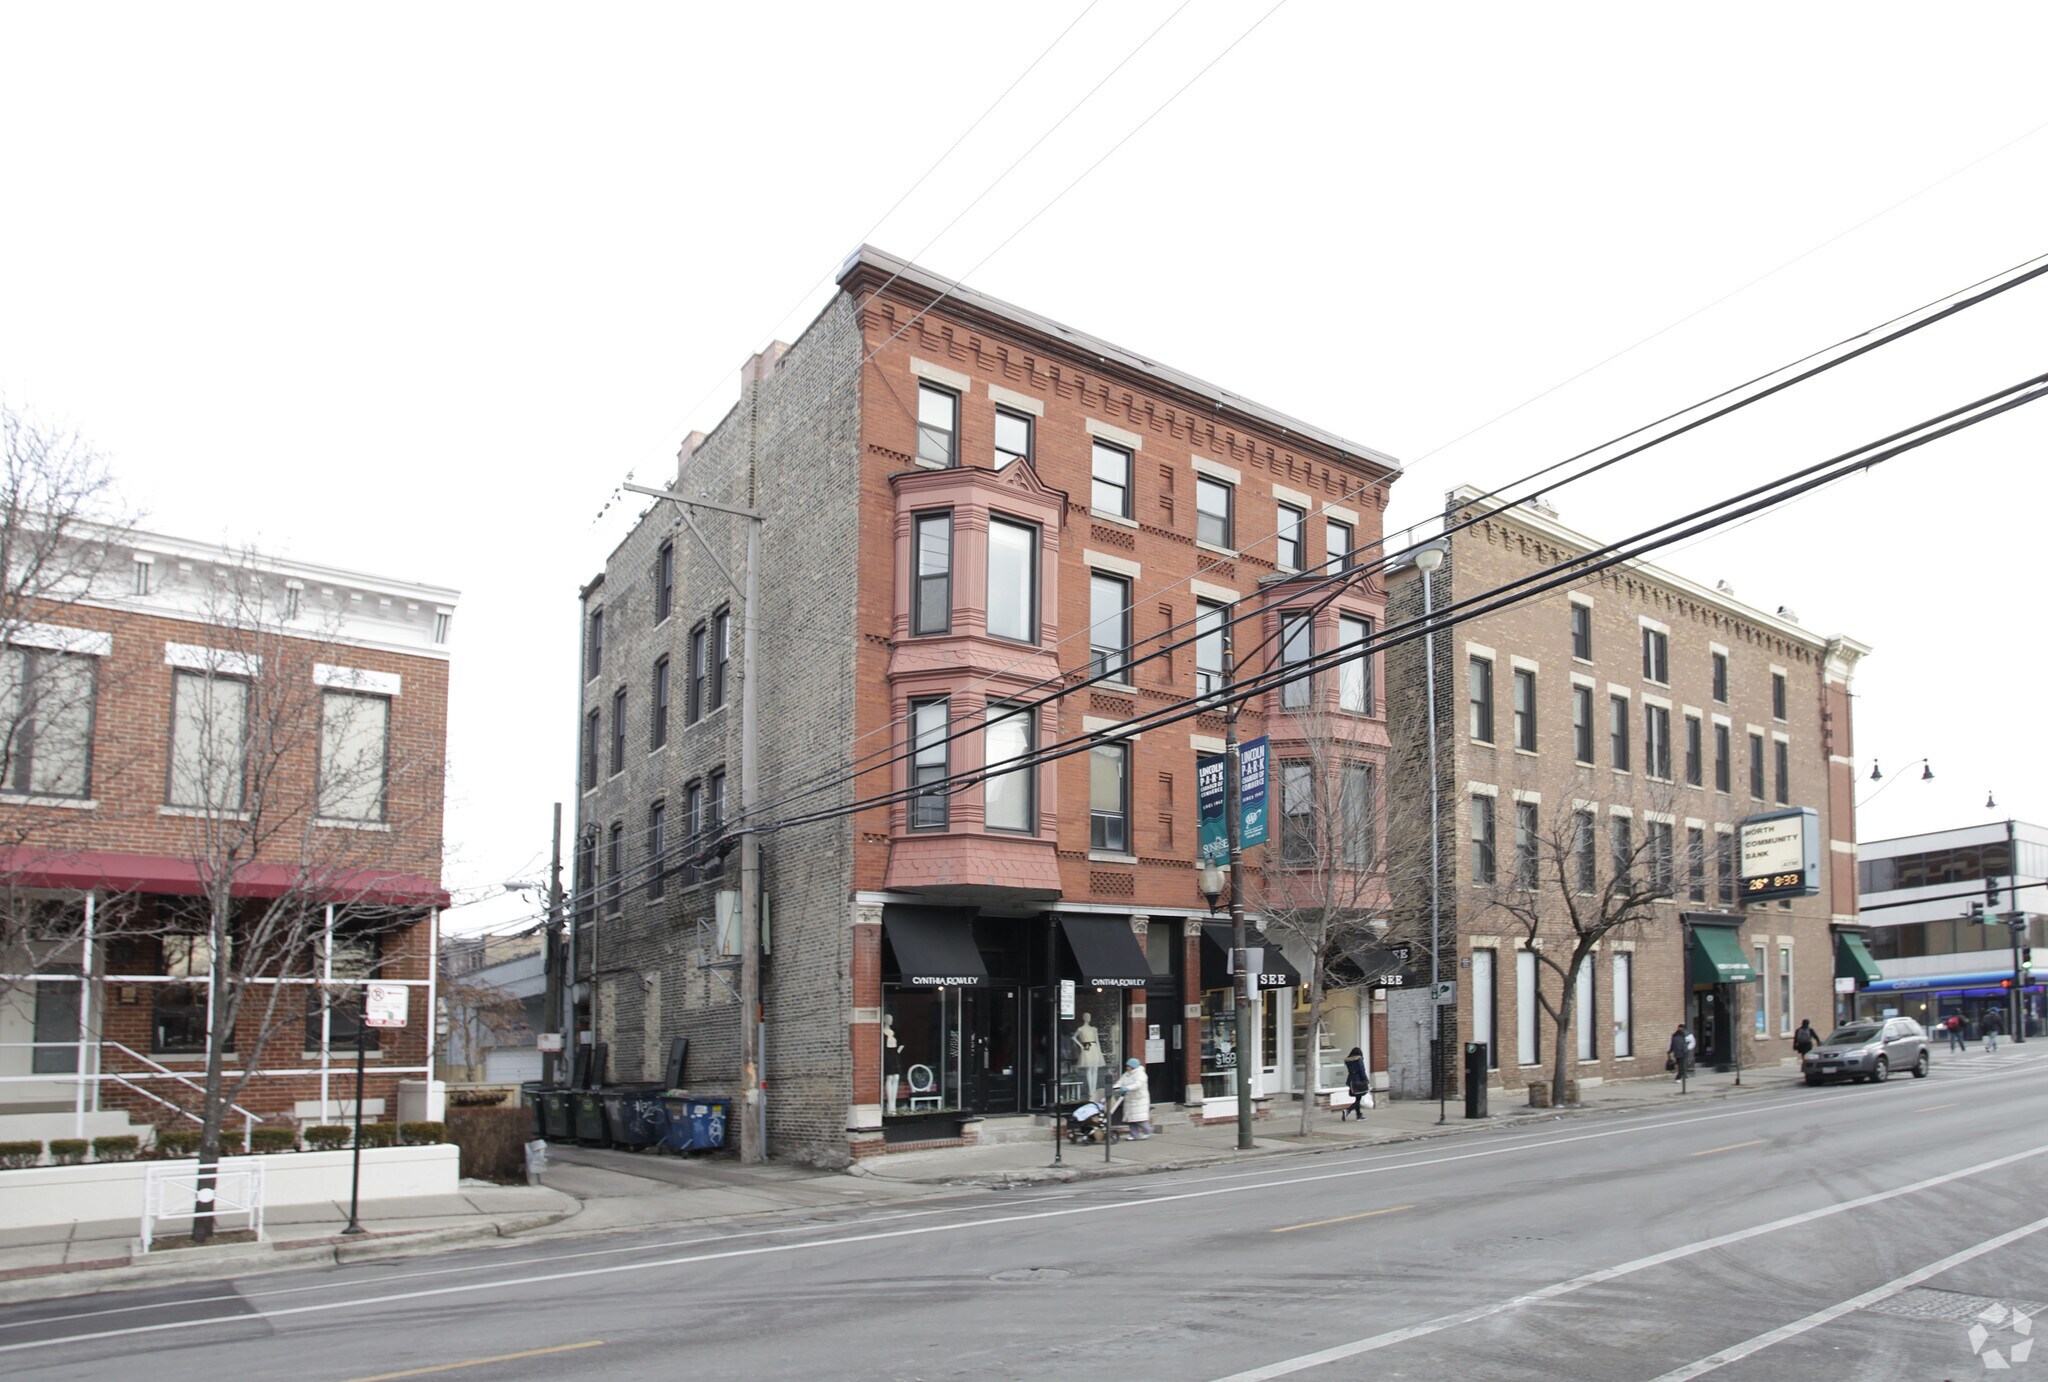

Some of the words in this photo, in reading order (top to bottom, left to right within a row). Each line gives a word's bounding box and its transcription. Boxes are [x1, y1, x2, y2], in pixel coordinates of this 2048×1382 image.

[1241, 745, 1265, 764] LINCOLN
[1199, 762, 1224, 778] LINCOLN
[1744, 826, 1775, 836] NORTH
[1745, 834, 1799, 848] COMMUNITY
[1745, 851, 1769, 860] BANK
[1391, 949, 1409, 959] EE
[912, 976, 944, 985] CYNTHIA
[943, 976, 979, 986] ROWLEY
[1117, 979, 1146, 987] ROWLEY
[1260, 974, 1286, 985] SEE
[1380, 975, 1403, 985] SEE
[1215, 1052, 1237, 1065] $169
